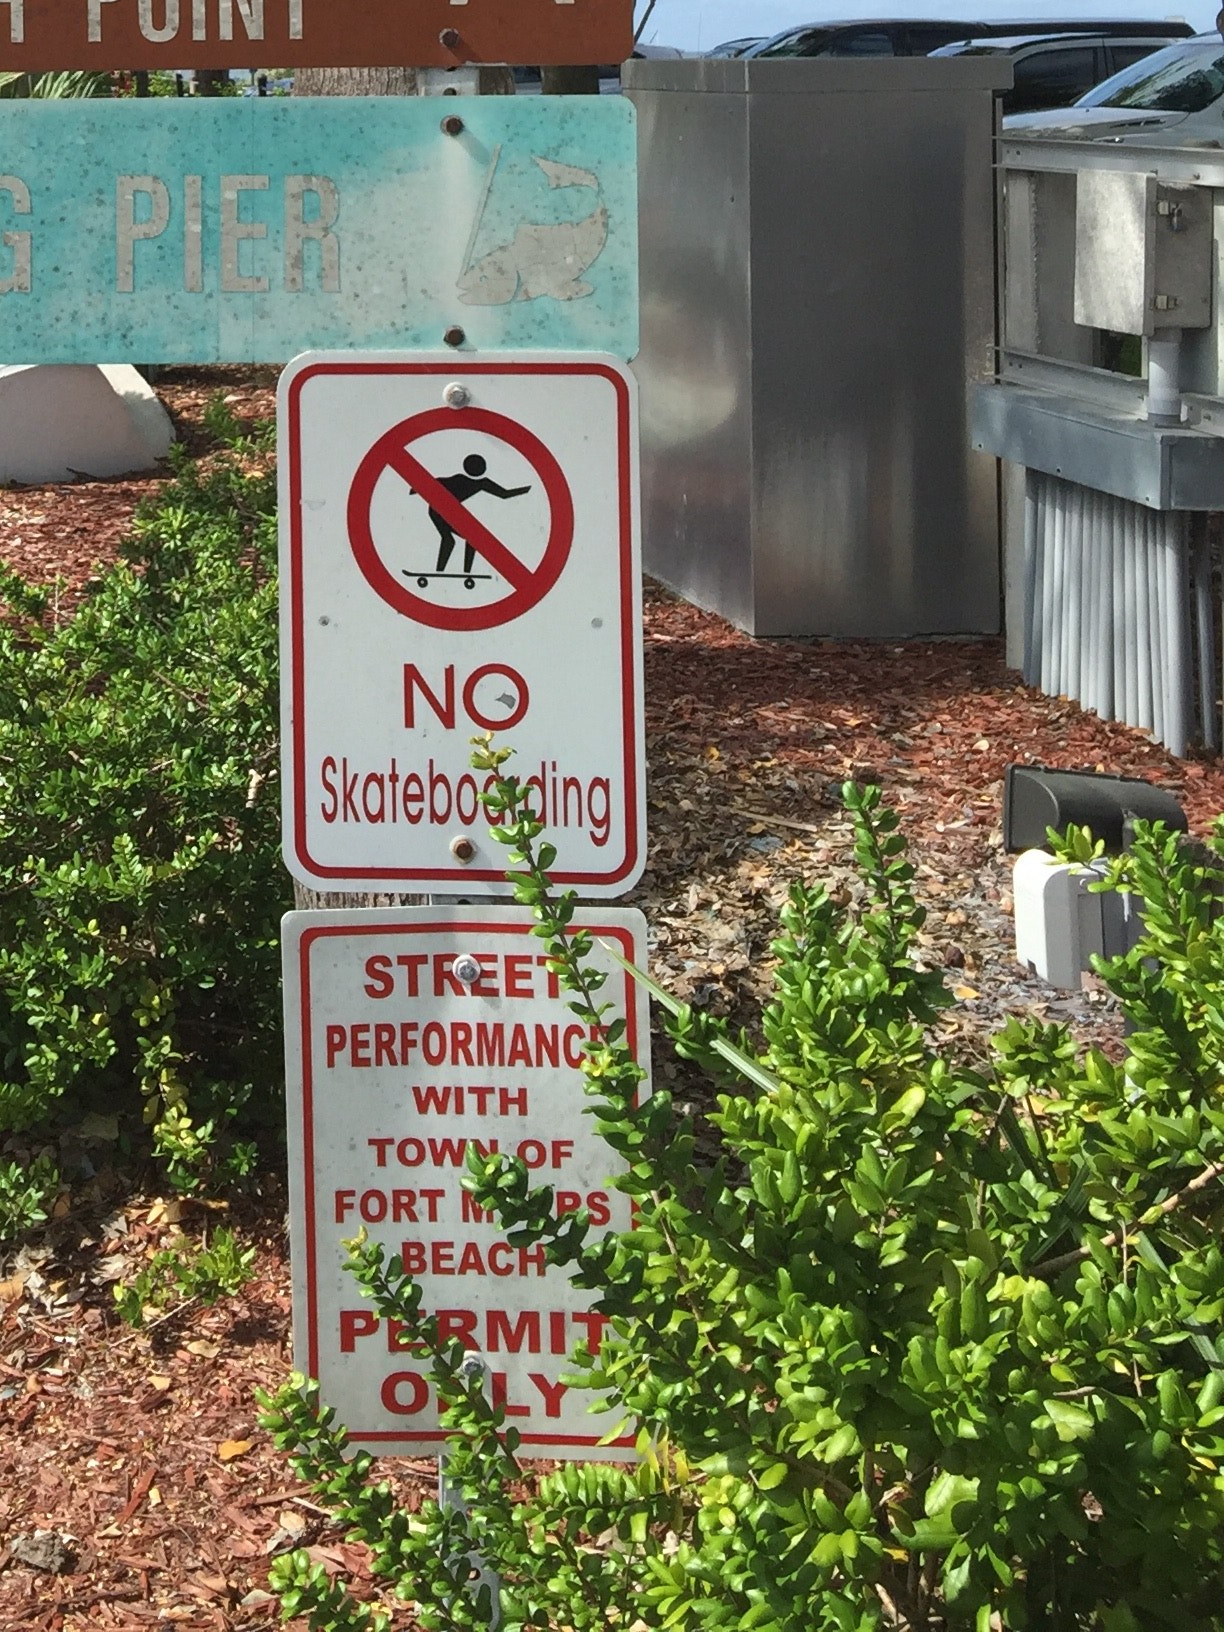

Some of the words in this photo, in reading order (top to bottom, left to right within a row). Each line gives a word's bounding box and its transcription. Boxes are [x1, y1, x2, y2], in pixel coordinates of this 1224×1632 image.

[116, 173, 341, 294] PIER
[403, 663, 530, 731] NO
[321, 755, 611, 847] Skateboading
[364, 953, 563, 999] STREET
[412, 1086, 529, 1116] WITH
[516, 1139, 574, 1169] OF
[334, 1189, 446, 1224] FORT
[461, 1190, 611, 1226] MRS
[401, 1241, 547, 1277] BEACH
[339, 1309, 612, 1356] PERMIT
[380, 1371, 570, 1418] OLY
